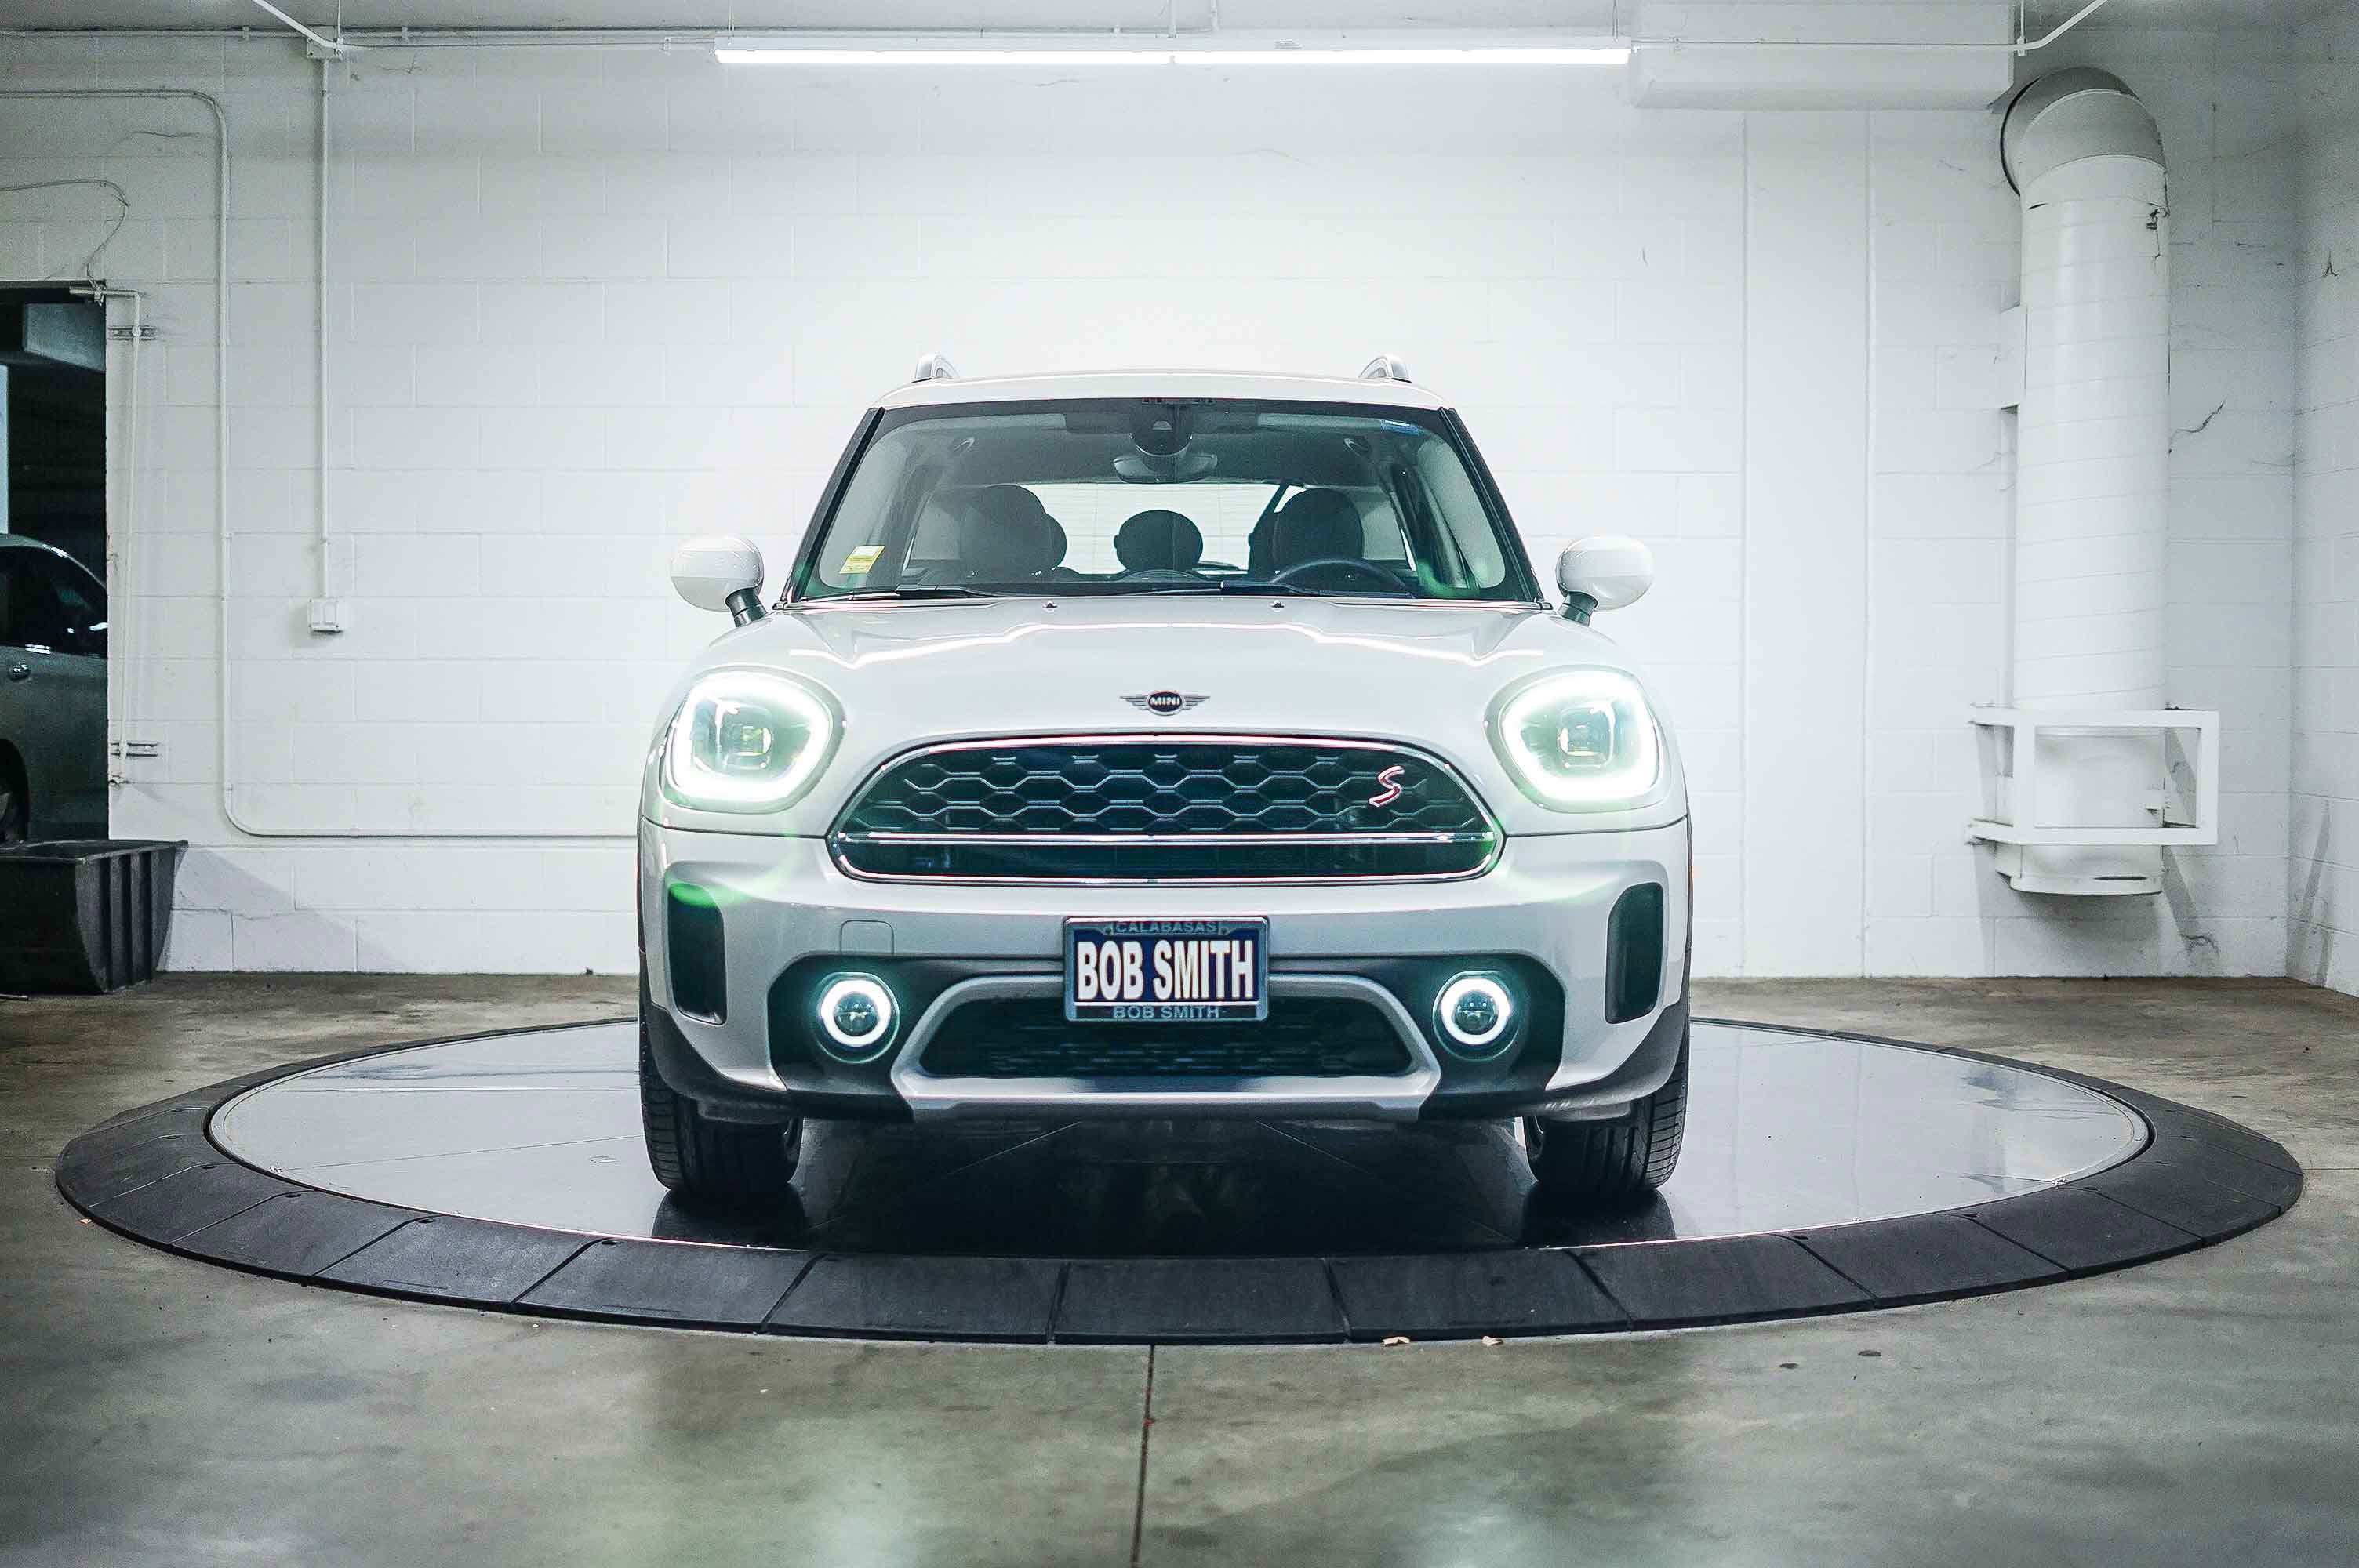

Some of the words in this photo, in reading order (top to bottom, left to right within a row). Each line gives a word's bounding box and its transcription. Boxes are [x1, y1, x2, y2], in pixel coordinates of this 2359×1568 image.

[1150, 696, 1180, 706] MINI
[1369, 765, 1405, 808] S
[1116, 921, 1216, 933] CALABASAS
[1077, 940, 1143, 1000] BOB
[1153, 940, 1254, 1000] SMITH
[1113, 1006, 1155, 1018] BOB
[1160, 1006, 1219, 1018] SMITH
